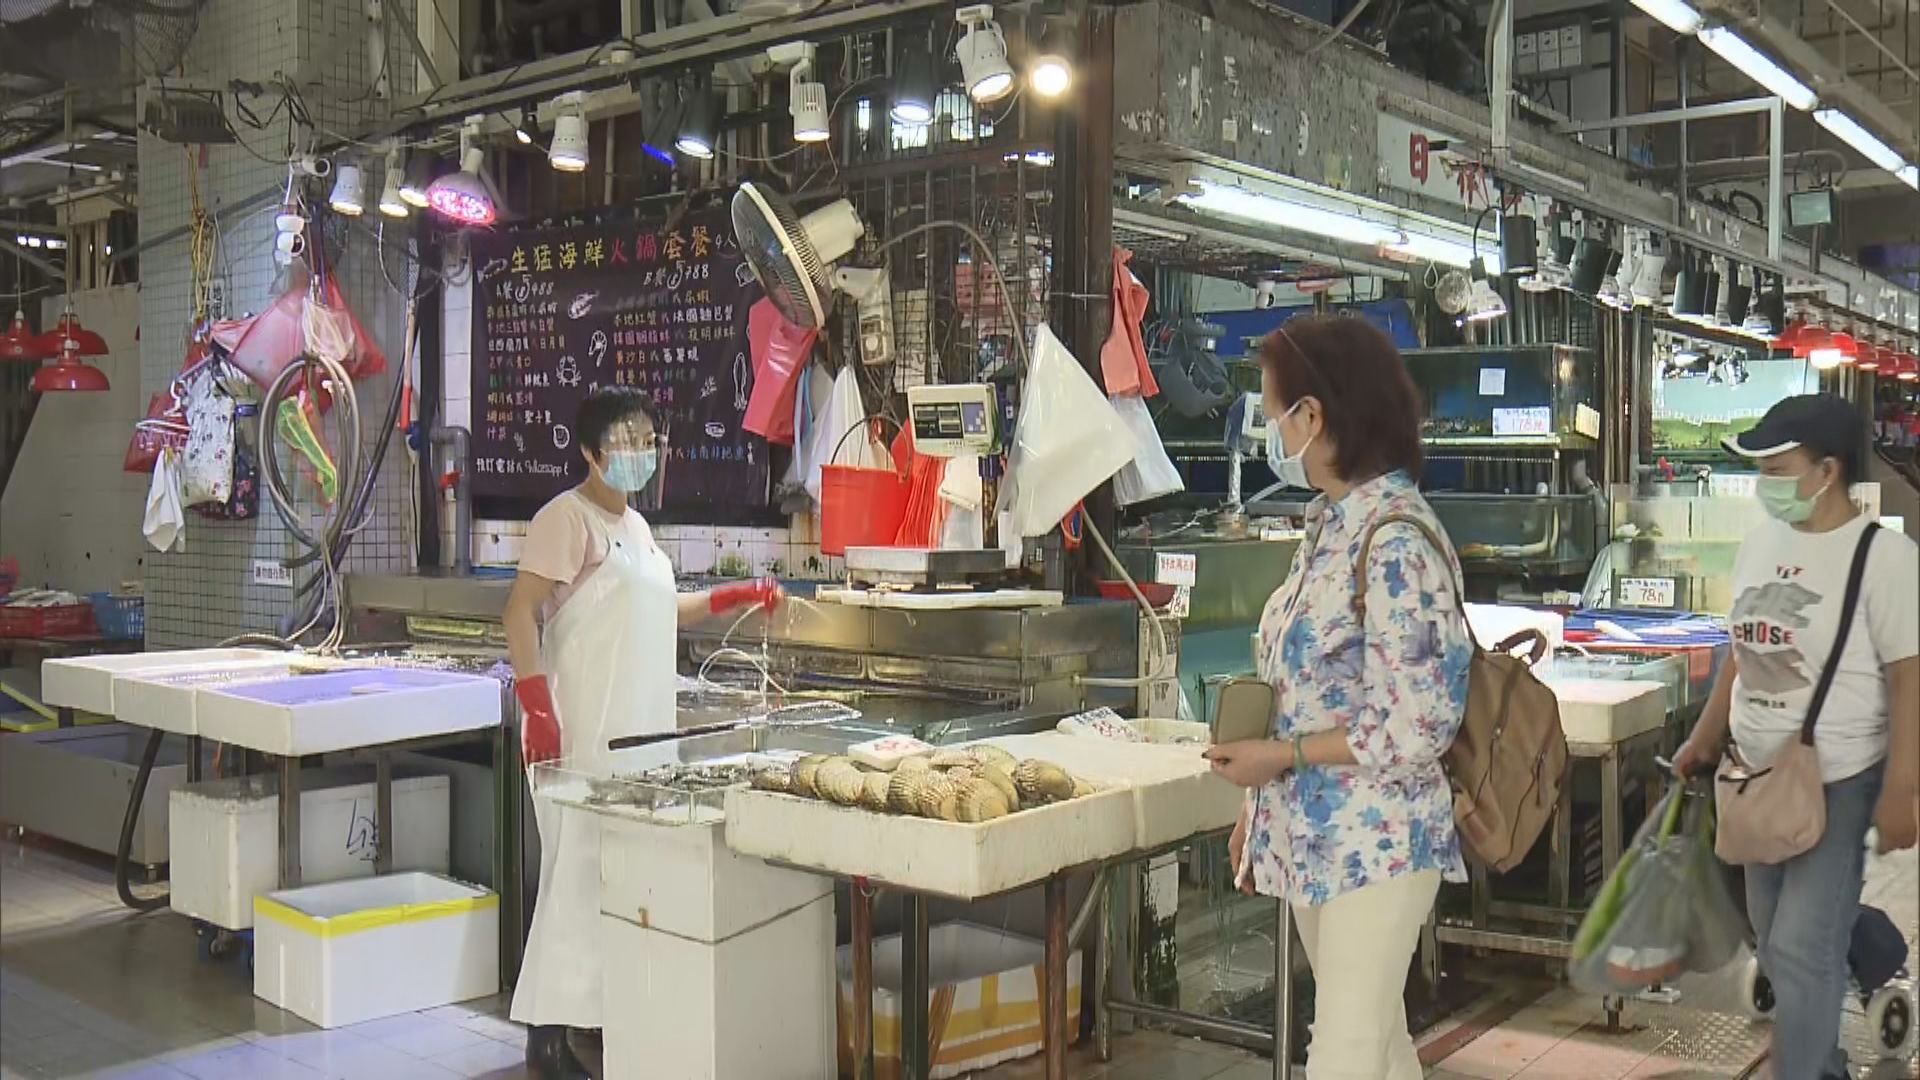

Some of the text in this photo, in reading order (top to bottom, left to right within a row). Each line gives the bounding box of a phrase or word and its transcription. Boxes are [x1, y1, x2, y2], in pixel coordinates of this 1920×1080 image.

[511, 225, 711, 273] 生猛海鮮火鍋套餐
